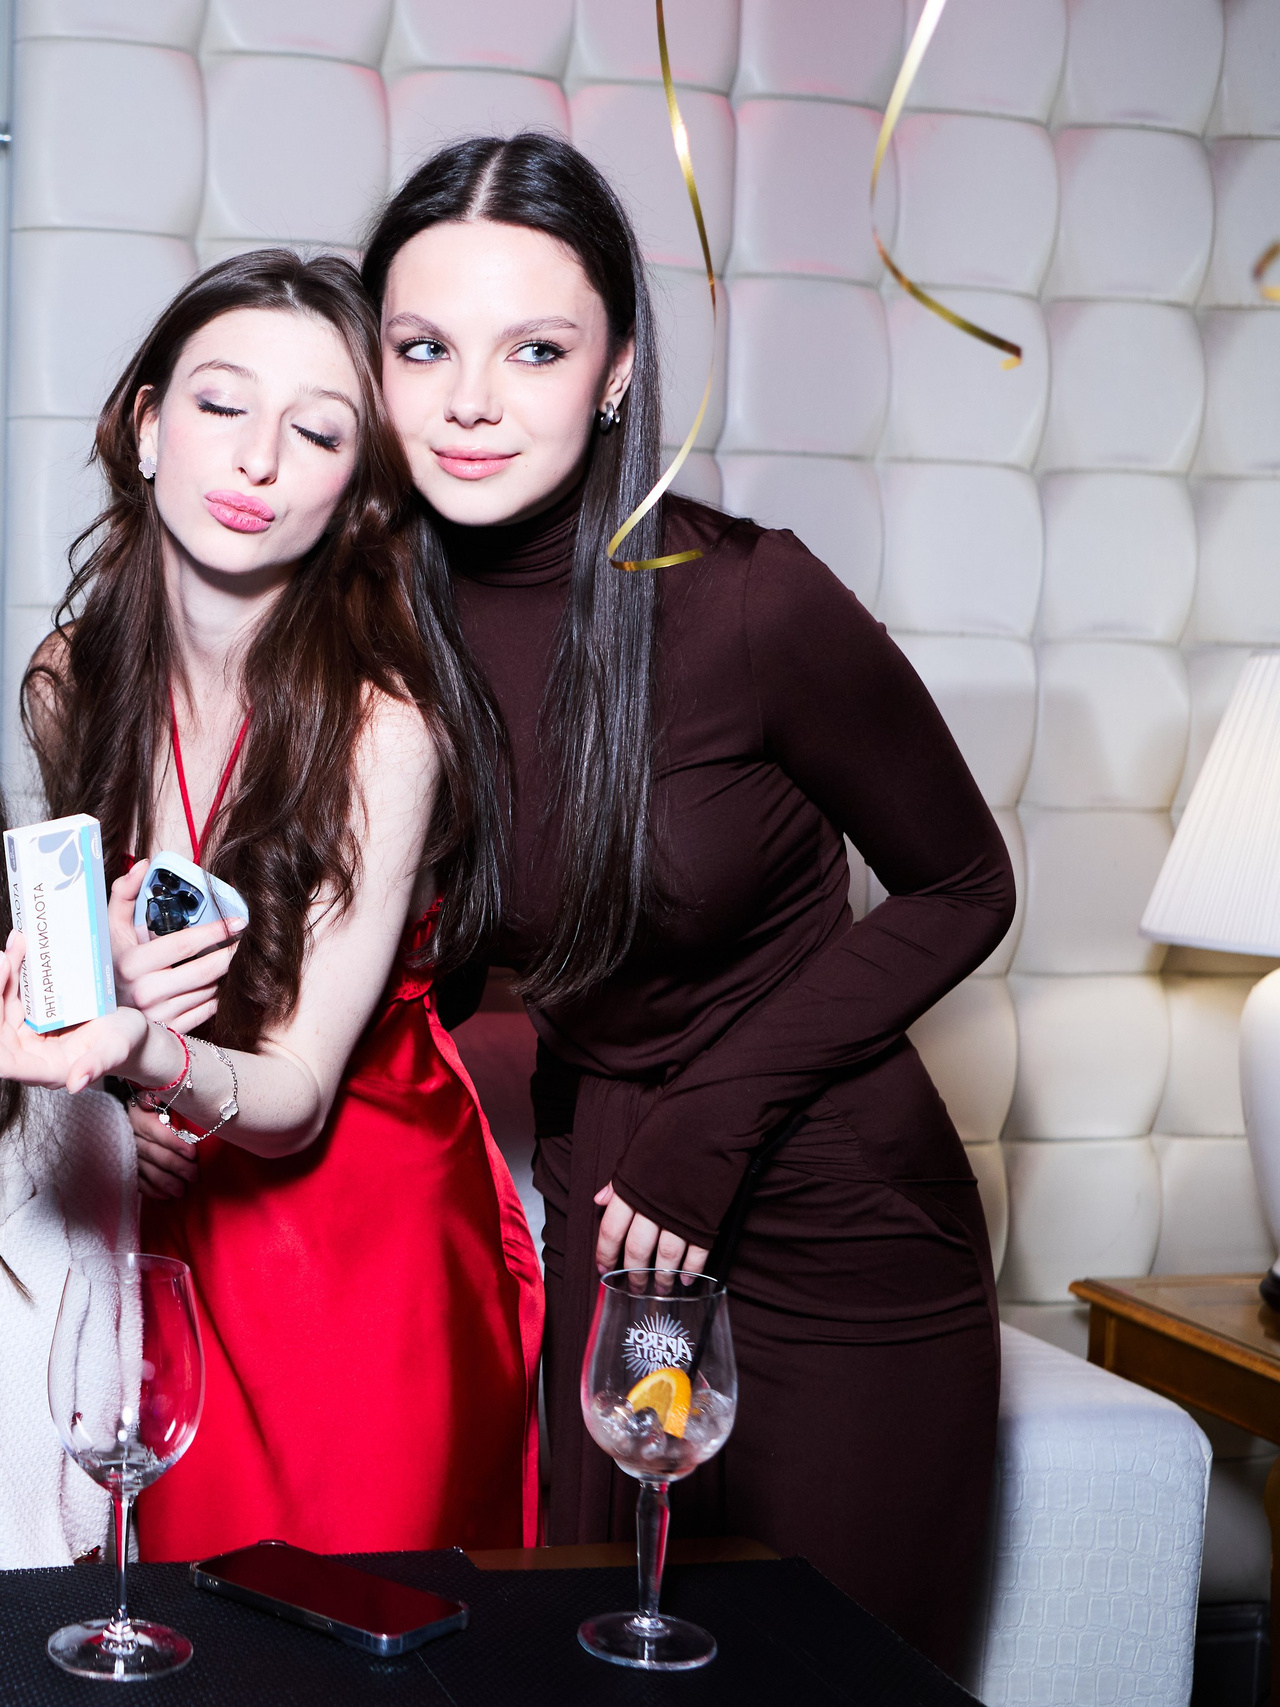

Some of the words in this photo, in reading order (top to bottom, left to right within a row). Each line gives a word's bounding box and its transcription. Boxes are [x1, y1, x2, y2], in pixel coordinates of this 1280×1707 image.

[12, 882, 24, 935] СЛОТА
[33, 883, 50, 950] КИСЛОТА
[20, 954, 33, 1017] ЯНТАРНА
[40, 952, 57, 1018] ЯНТАРНАЯ
